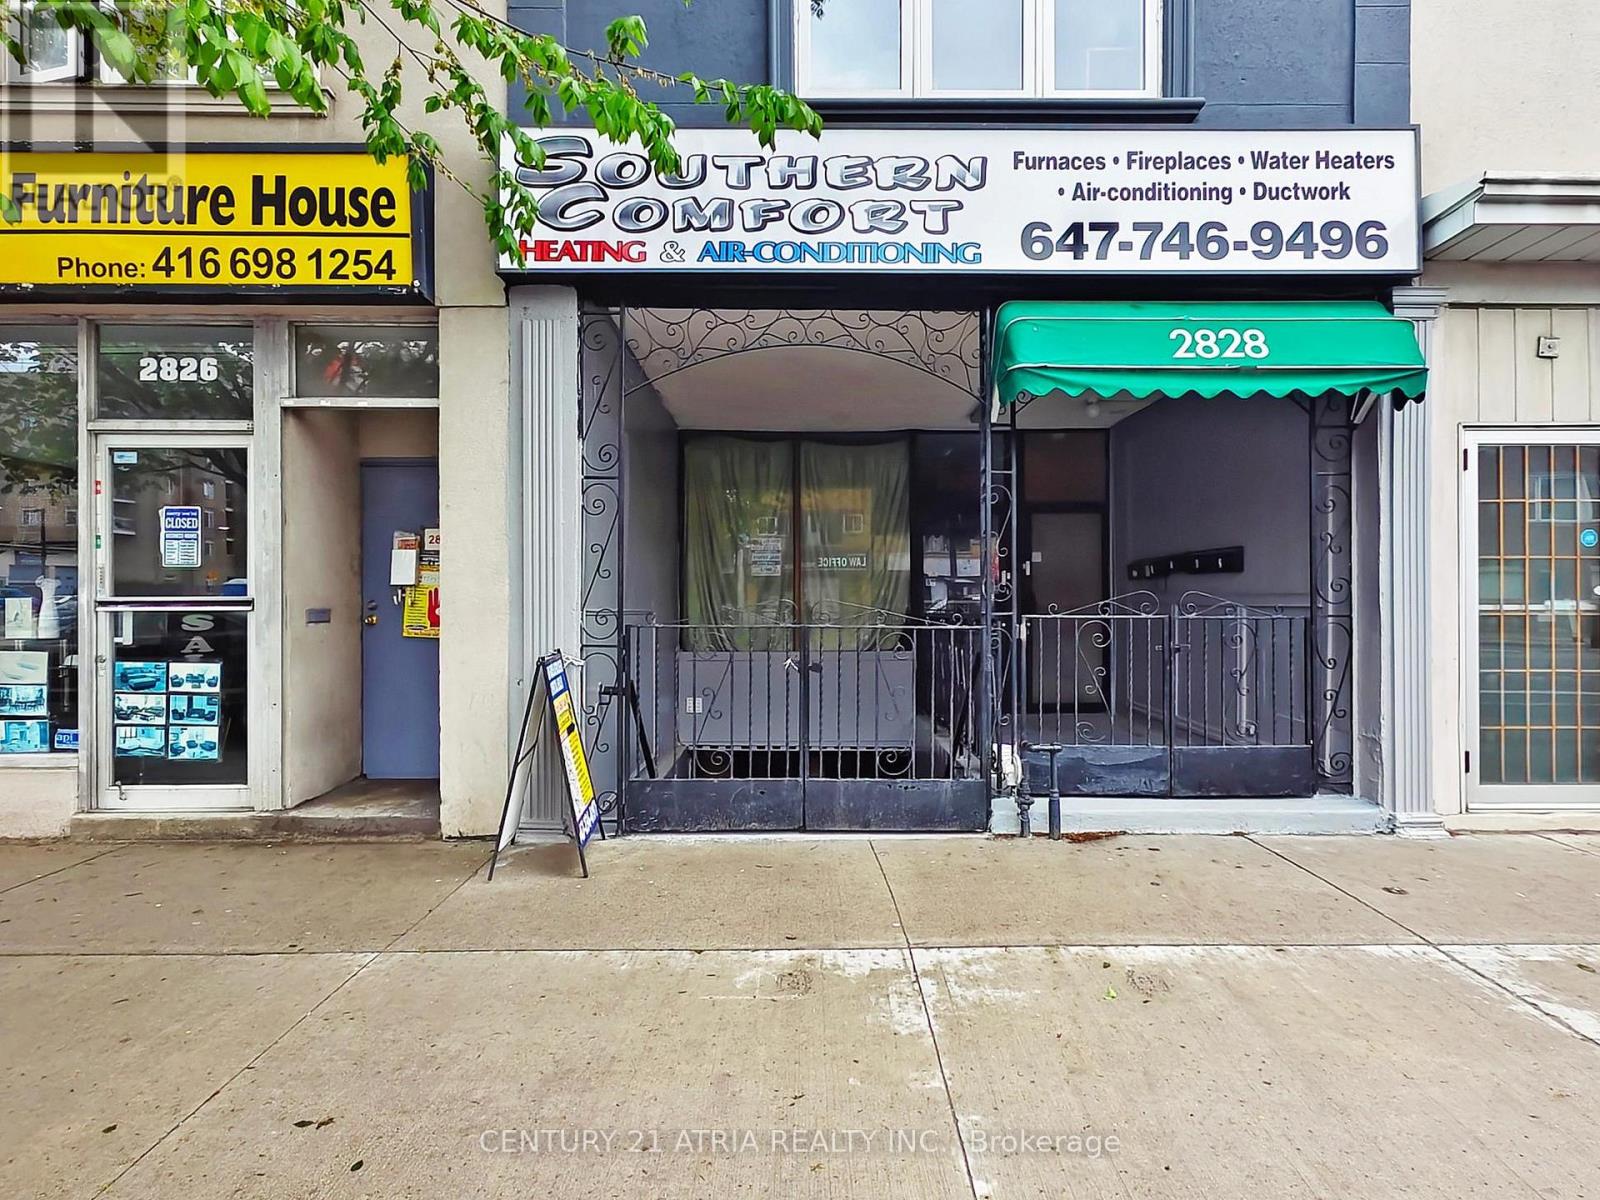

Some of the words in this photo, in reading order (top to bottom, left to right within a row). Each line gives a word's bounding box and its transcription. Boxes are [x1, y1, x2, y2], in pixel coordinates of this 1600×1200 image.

[514, 135, 988, 191] SOUTHERN
[1013, 151, 1106, 171] Furnaces
[1126, 151, 1231, 175] Fireplaces
[1250, 151, 1309, 170] Water
[1315, 151, 1395, 170] Heaters
[11, 171, 235, 226] Furniture
[251, 175, 397, 228] House
[537, 180, 964, 235] COMFORT
[1072, 182, 1233, 205] Air-conditioning
[1253, 182, 1351, 202] Ductwork
[519, 240, 647, 262] HEATING
[660, 241, 685, 263] &
[697, 241, 982, 264] AIR-CONDITIONING
[1020, 221, 1389, 261] 647-746-9496
[57, 256, 146, 279] Phone:
[152, 247, 221, 279] 416
[230, 248, 297, 280] 698
[307, 249, 396, 281] 1254
[1169, 328, 1270, 360] 2828
[139, 356, 219, 382] 2826
[165, 517, 198, 529] CLOSED
